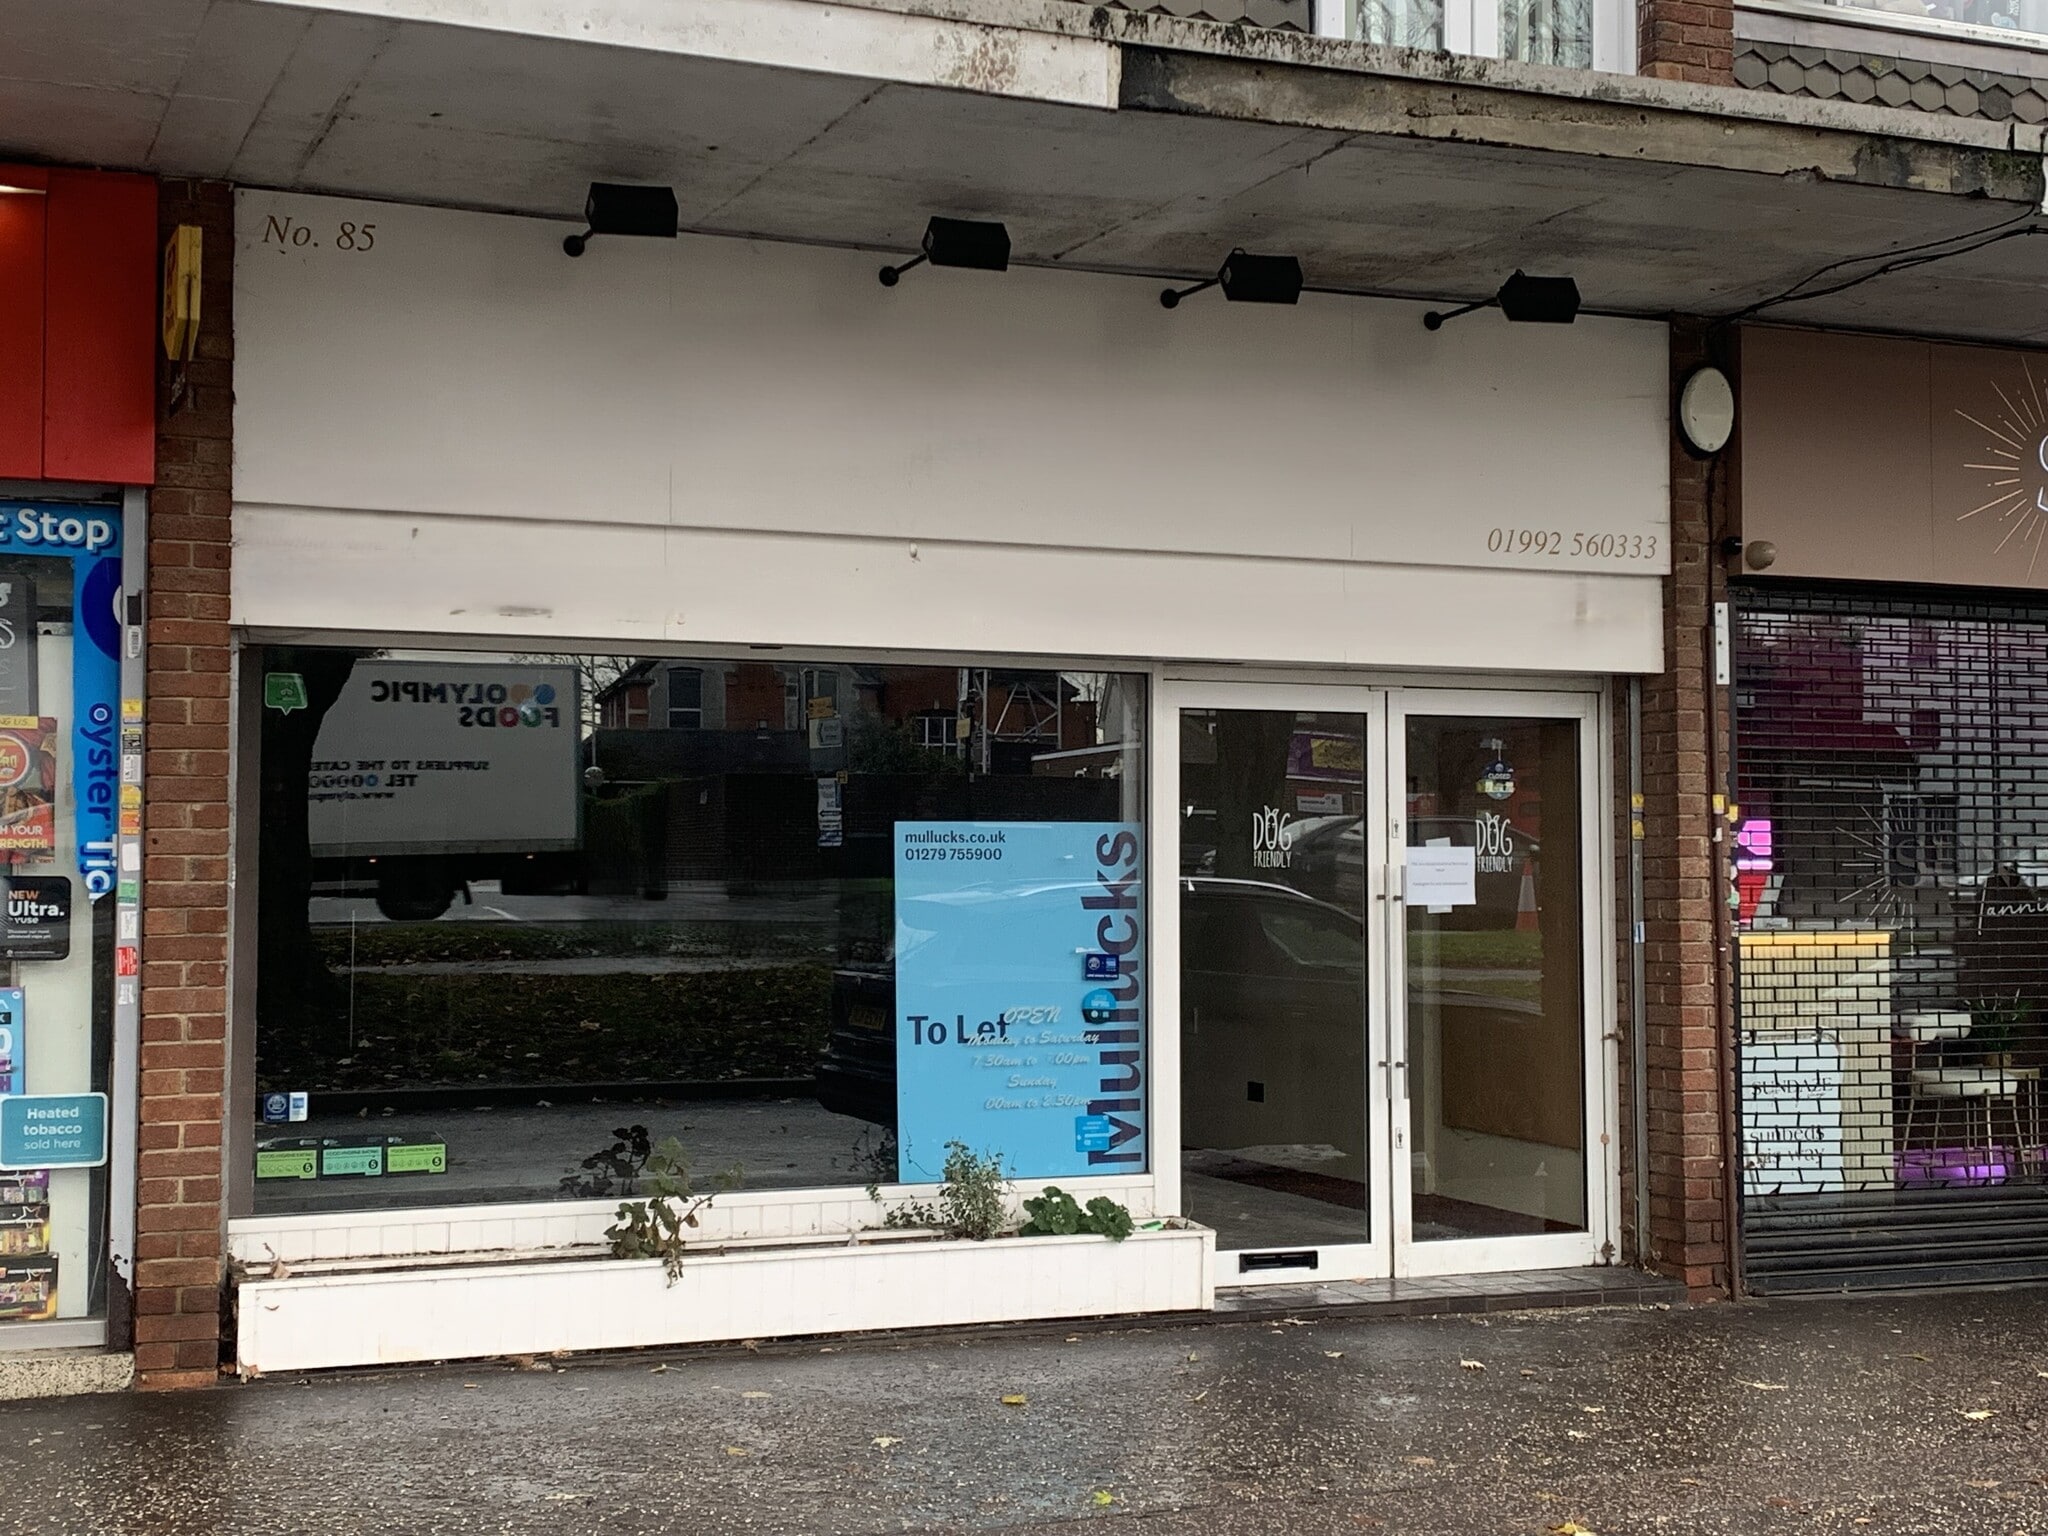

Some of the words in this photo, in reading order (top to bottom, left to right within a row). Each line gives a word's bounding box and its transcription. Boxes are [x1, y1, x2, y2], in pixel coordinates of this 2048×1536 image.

[262, 215, 318, 247] No.
[336, 221, 376, 251] 85
[16, 508, 110, 550] Stop
[1487, 528, 1562, 555] 01992
[1570, 533, 1657, 559] 560333
[11, 825, 43, 835] YOUR
[1253, 805, 1292, 851] DOG
[1476, 812, 1513, 856] DOG
[905, 830, 1006, 844] mullucks.co.uk
[905, 848, 946, 861] 01279
[950, 848, 1003, 861] 755900
[1253, 851, 1292, 868] FRIENDLY
[1476, 856, 1513, 872] FRIENDLY
[8, 890, 39, 899] NEW
[8, 901, 65, 916] Ultra.
[1081, 830, 1142, 1167] Mullucks
[1003, 1007, 1062, 1024] OPEN
[907, 1015, 947, 1045] To
[958, 1013, 1010, 1044] Let
[967, 1033, 1020, 1048] Monday
[1038, 1030, 1100, 1045] Saturday
[1007, 1073, 1058, 1089] Sunday
[27, 1107, 79, 1119] Heated
[23, 1123, 82, 1136] tobacco
[24, 1140, 50, 1150] sold
[54, 1138, 81, 1149] here
